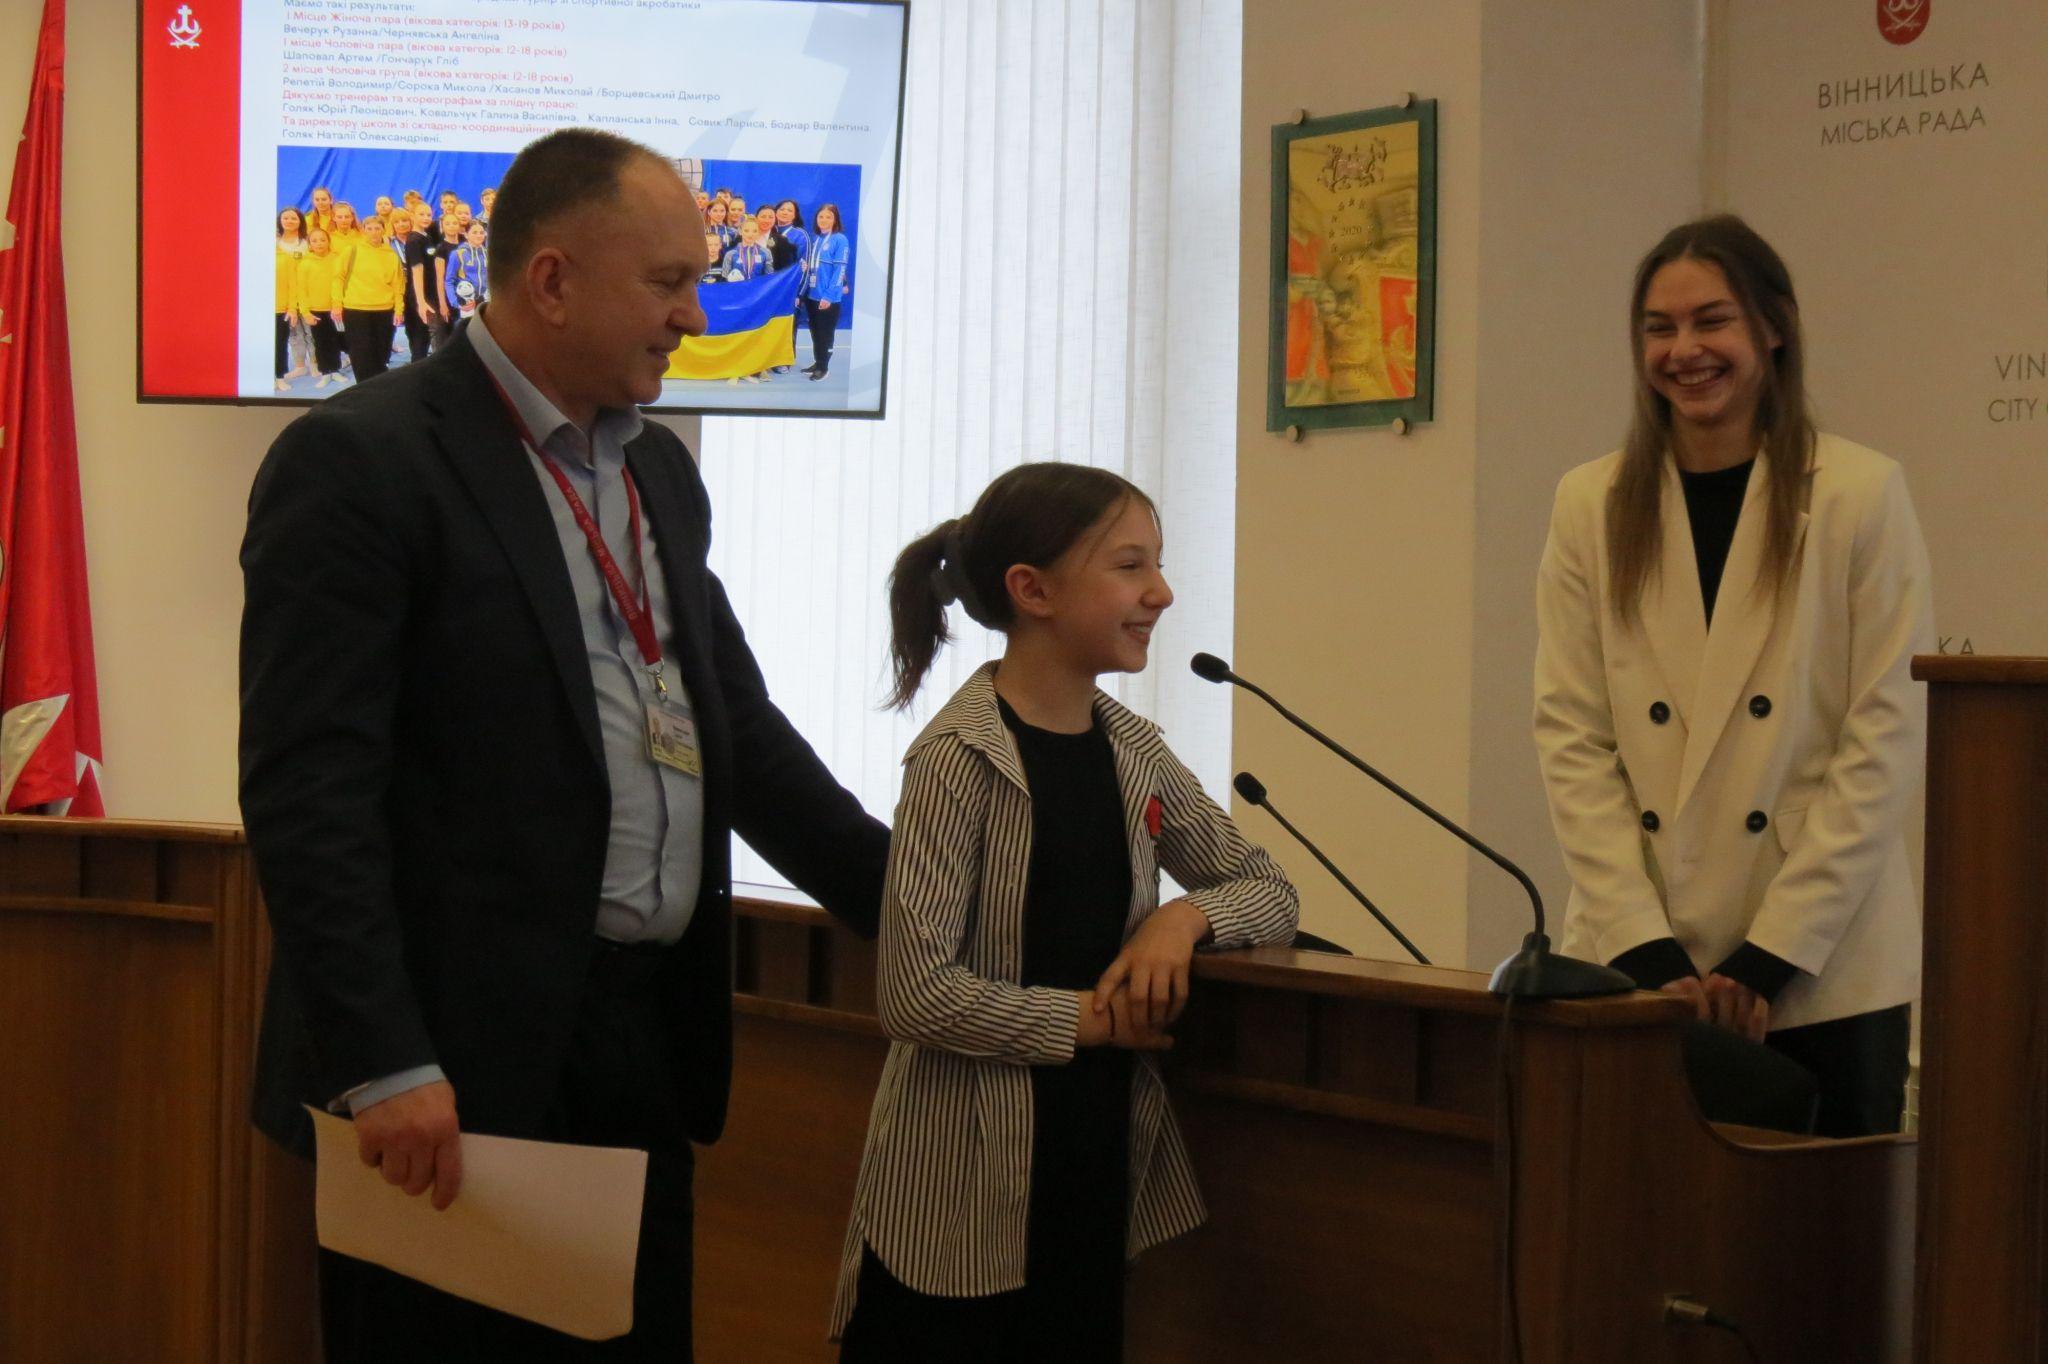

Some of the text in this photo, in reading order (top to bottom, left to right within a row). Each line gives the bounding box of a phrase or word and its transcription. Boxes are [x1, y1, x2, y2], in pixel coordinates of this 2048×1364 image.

[284, 0, 415, 12] Маємо такі результати:
[293, 11, 327, 22] Місце
[330, 12, 372, 22] Жіноча
[374, 16, 400, 26] пара
[404, 16, 443, 26] (вікова
[446, 18, 500, 30] категорія:
[504, 19, 529, 30] 13-19
[532, 21, 565, 32] років)
[284, 24, 330, 36] Вечерук
[451, 30, 500, 41] Ангеліна
[283, 50, 334, 62] Шаповал
[338, 53, 373, 64] Артем
[436, 56, 460, 66] Гліб
[290, 38, 322, 48] місце
[324, 40, 374, 50] Чоловіча
[378, 44, 404, 54] пара
[407, 42, 446, 54] (вікова
[448, 46, 503, 58] категорія:
[506, 46, 530, 56] 12-18
[534, 48, 567, 58] років)
[282, 64, 574, 84] 2 місце Чоловіча група (вікова категорія: 12-18 років)
[443, 82, 486, 92] Микола
[544, 86, 592, 97] Миколай
[678, 90, 720, 103] Дмитро
[1818, 62, 1989, 109] ВІННИЦЬКА
[282, 90, 331, 102] Дякуємо
[336, 94, 388, 104] тренерам
[406, 96, 482, 108] хореографам
[500, 98, 536, 110] плідну
[282, 103, 314, 113] Голяк
[318, 104, 347, 115] Юрій
[420, 108, 478, 120] Ковальчук
[480, 110, 519, 120] Галина
[688, 116, 722, 127] Совик
[770, 120, 810, 132] Боднар
[282, 116, 296, 126] Та
[298, 117, 357, 128] директору
[361, 119, 397, 128] школи
[400, 120, 408, 128] зі
[1821, 106, 1986, 147] МІСЬКА РАДА
[282, 128, 313, 139] Голяк
[317, 130, 356, 140] Наталії
[1995, 353, 2046, 380] VIN
[1988, 398, 2038, 422] CITY
